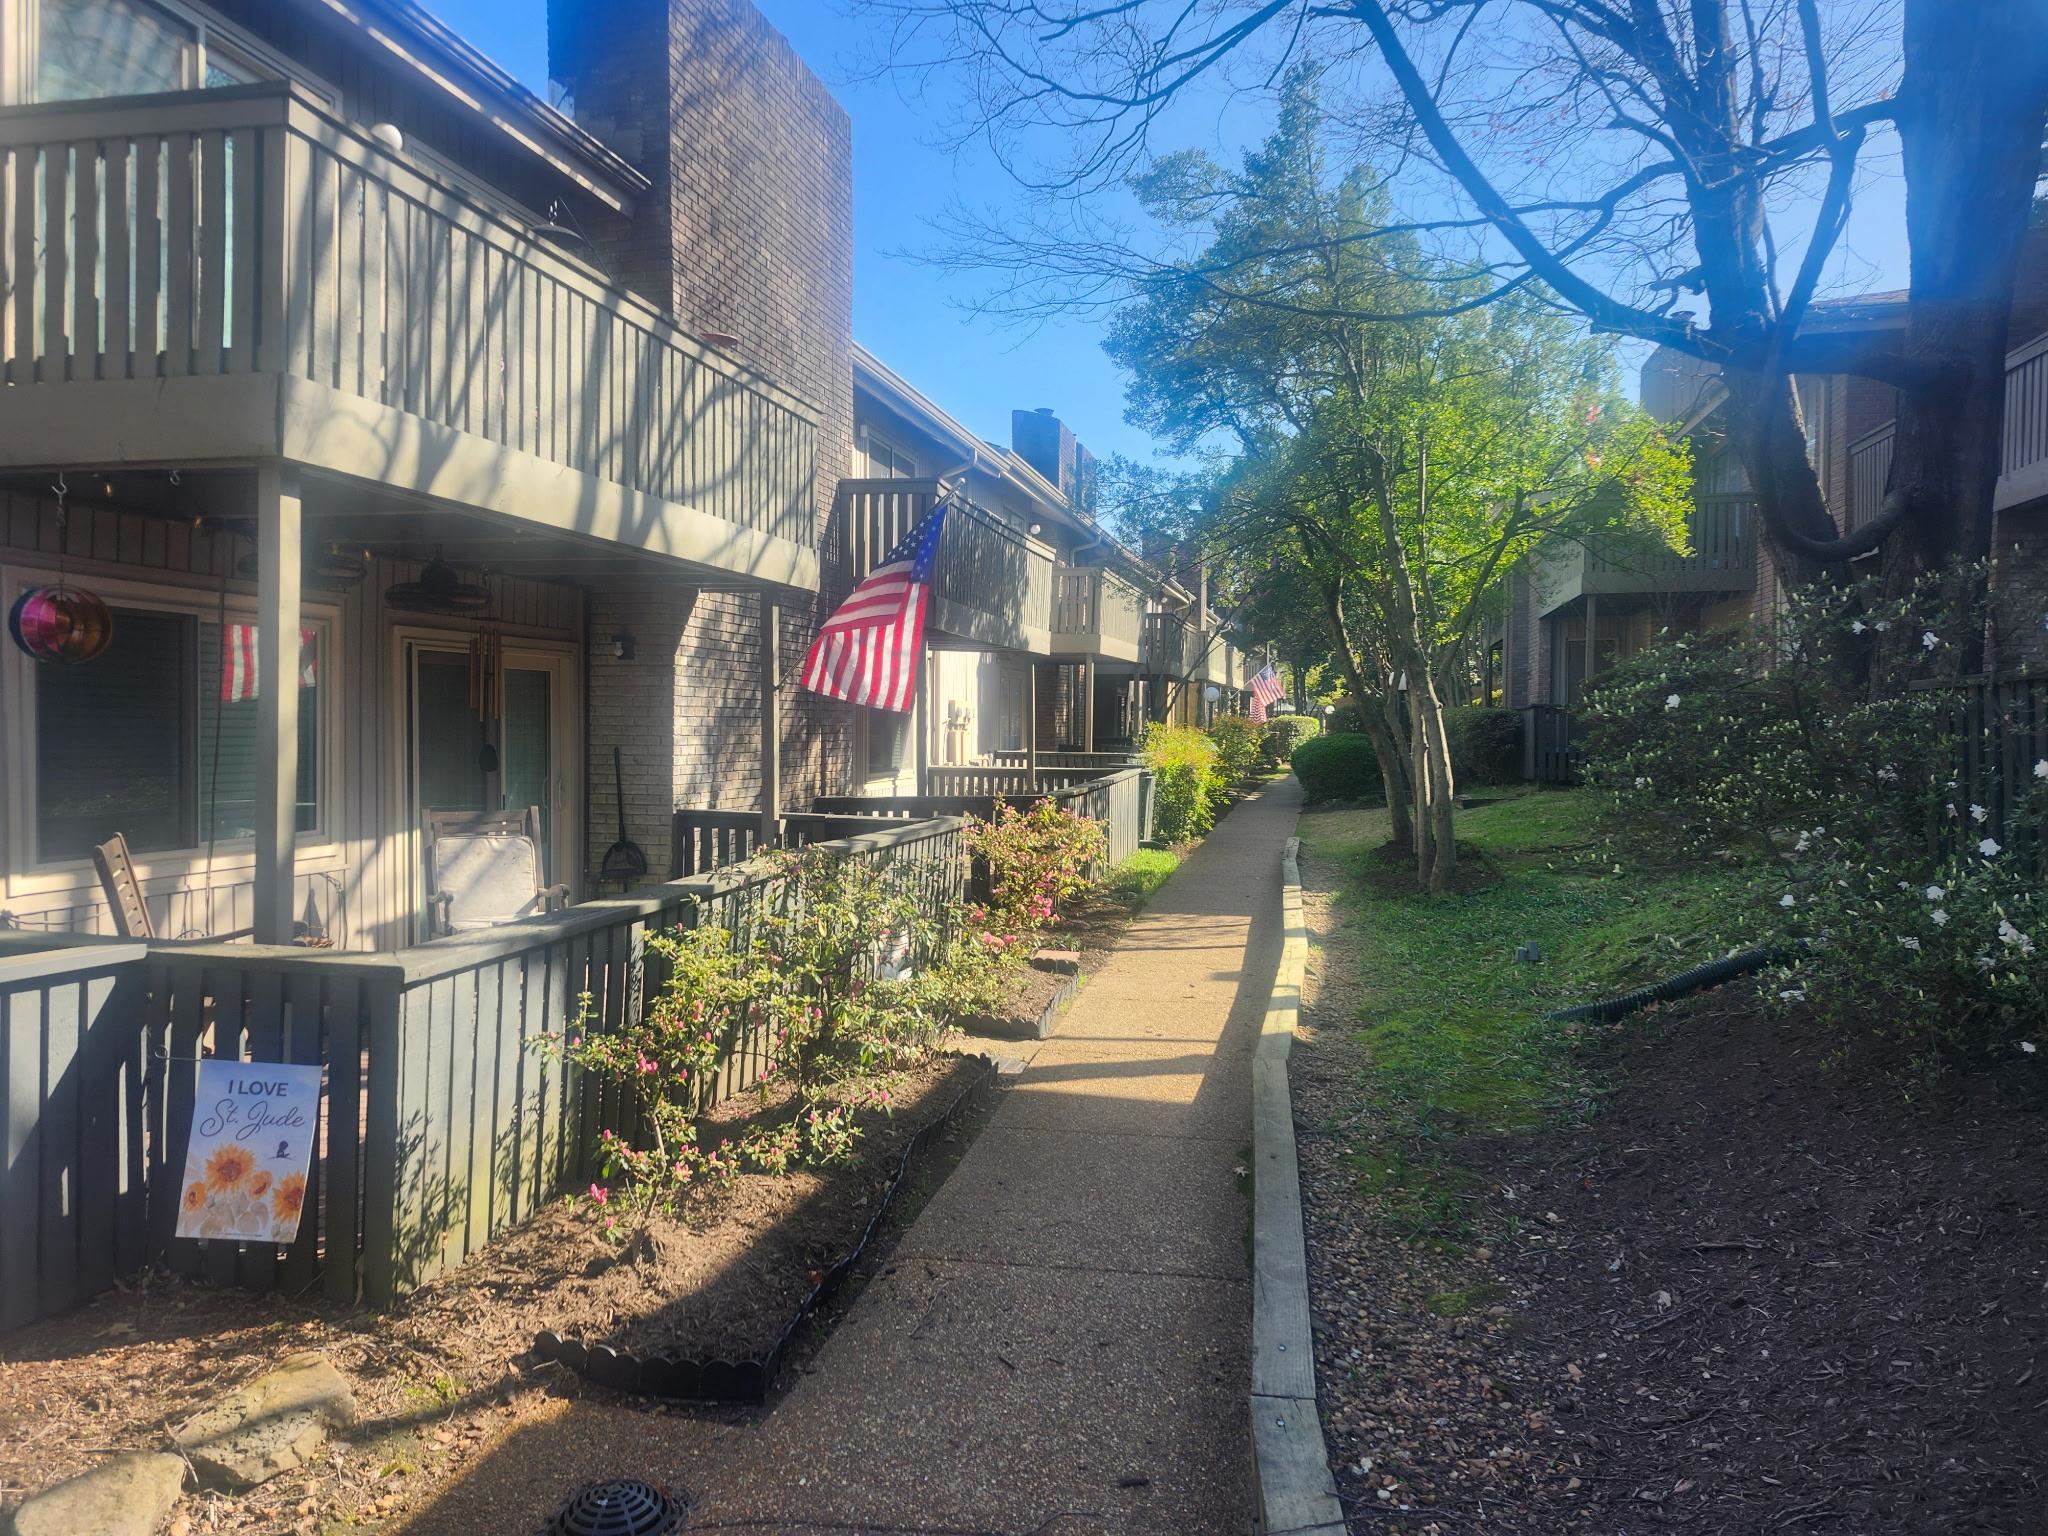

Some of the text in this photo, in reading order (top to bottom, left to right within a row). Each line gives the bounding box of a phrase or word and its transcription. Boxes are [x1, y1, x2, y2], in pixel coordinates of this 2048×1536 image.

[228, 1080, 289, 1097] I LOVE
[200, 1098, 305, 1141] St. Jude
